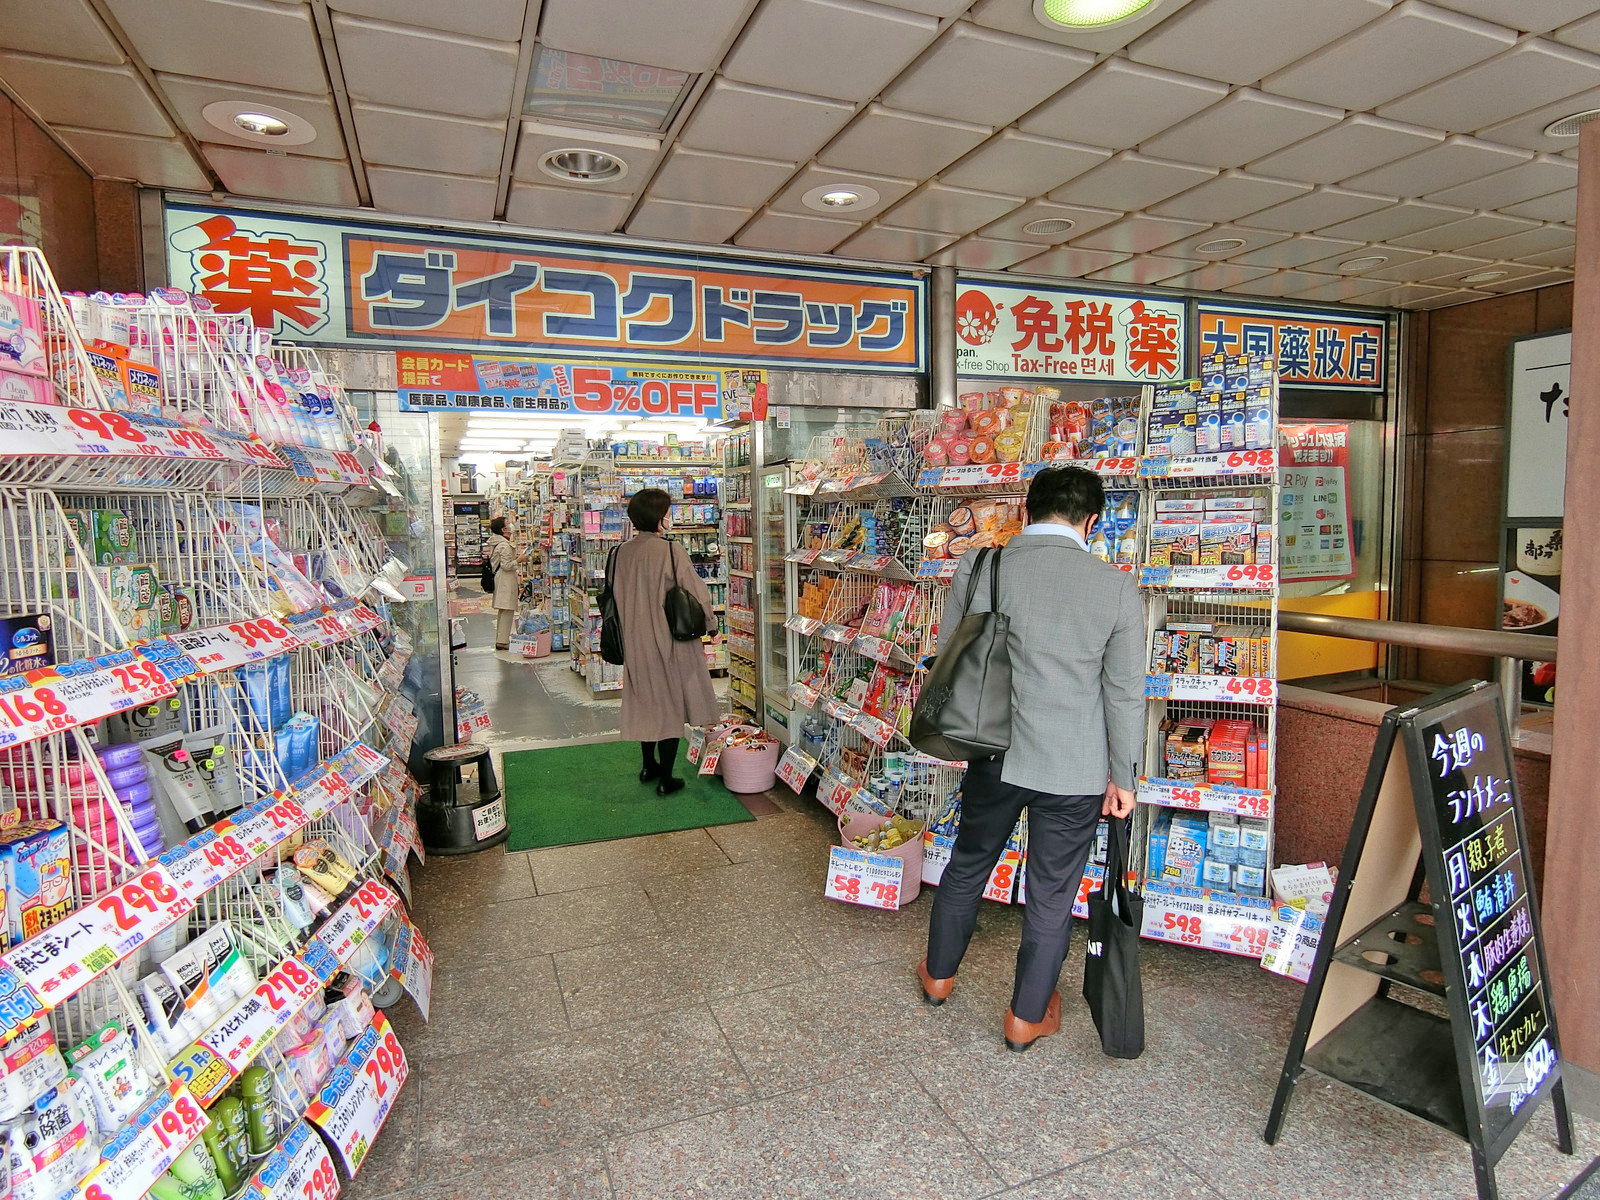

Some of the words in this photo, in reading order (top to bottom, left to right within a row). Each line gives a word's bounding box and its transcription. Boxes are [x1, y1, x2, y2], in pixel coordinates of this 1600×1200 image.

[199, 233, 323, 331] 薬
[361, 248, 909, 351] ダイコクドラッグ
[1010, 295, 1116, 356] 免税
[1129, 313, 1178, 376] 薬
[401, 357, 470, 373] 会員カード
[985, 360, 1010, 374] Shop
[1011, 354, 1077, 374] Tax-Free
[1080, 357, 1115, 376] 면세
[402, 371, 442, 386] 提示で
[552, 365, 572, 397] さらに
[572, 368, 718, 414] 5%OFF
[722, 389, 738, 401] EVE
[408, 393, 569, 410] 医薬品、健康食品、衛生用品が
[1540, 381, 1571, 424] た
[68, 409, 148, 442] 98
[88, 443, 110, 453] 128
[138, 443, 165, 455] 107
[167, 429, 217, 450] 478
[202, 449, 225, 458] 525
[237, 440, 277, 461] 148
[1172, 456, 1218, 464] ウナ虫よけ当番
[1226, 449, 1274, 468] 698
[331, 451, 364, 474] 198
[945, 467, 983, 475] スープはるさめ
[986, 463, 1020, 478] 98
[1095, 457, 1136, 470] 198
[1227, 564, 1273, 581] 698
[350, 606, 378, 624] 198
[229, 618, 288, 648] 398
[316, 616, 344, 635] 298
[177, 632, 231, 651] 温泡クール
[281, 637, 300, 648] 437
[877, 640, 893, 656] 58
[55, 657, 97, 678] 今だけ
[198, 653, 225, 665] 各種
[112, 660, 166, 693] 258
[1174, 677, 1218, 686] ブラックキャップ
[151, 683, 174, 698] 283
[1226, 678, 1273, 696] 498
[0, 688, 67, 727] 168
[119, 698, 134, 708] 348
[46, 713, 78, 732] 184
[475, 715, 490, 728] 138
[354, 744, 379, 766] 198
[703, 756, 716, 769] 138
[1211, 750, 1242, 762] ホウ酸ダンゴ
[1431, 727, 1484, 778] 今週の
[179, 774, 193, 782] GEL
[782, 762, 794, 776] 128
[319, 771, 347, 796] 348
[831, 783, 852, 809] 158
[1171, 788, 1201, 803] 548
[1237, 796, 1270, 811] 298
[265, 799, 303, 828] 298
[293, 813, 310, 827] 327
[477, 811, 503, 827] お使い下さい
[481, 803, 500, 817] ご自由に
[1252, 809, 1269, 817] 327
[203, 835, 245, 867] 498
[233, 852, 253, 867] 547
[1449, 851, 1467, 895] 月
[1467, 823, 1508, 873] 親子煮
[830, 860, 864, 872] キレートレモン
[834, 874, 861, 895] 58
[870, 881, 899, 901] 78
[989, 887, 1008, 900] 192
[1146, 881, 1170, 894] 今だけ
[1174, 886, 1203, 899] 値下げ!
[1292, 887, 1320, 897] 立体マスク
[98, 871, 178, 931] 298
[349, 881, 388, 919] 298
[384, 894, 398, 909] 327
[844, 893, 860, 902] 62
[1210, 892, 1236, 904] 今だけ
[1240, 896, 1272, 910] 値下げ!
[166, 897, 193, 919] 327
[1207, 906, 1272, 923] 虫よけサマーリキッド
[1164, 912, 1202, 935] 598
[1457, 902, 1476, 940] 火
[125, 931, 145, 949] 720
[1180, 934, 1202, 944] 657
[1230, 924, 1269, 946] 298
[13, 921, 94, 976] 熱さまシート
[40, 962, 82, 993] 各種
[1468, 951, 1484, 988] 水
[255, 960, 309, 1010] 278
[298, 978, 319, 1000] 305
[211, 998, 262, 1048] メンズビオレ洗顔
[1472, 1000, 1494, 1041] 木
[89, 1052, 110, 1069] キレイ
[111, 1037, 131, 1054] キレイ
[1482, 1045, 1499, 1094] 金
[1499, 1010, 1541, 1064] 牛すじカレー
[320, 1064, 355, 1108] 今だけ
[347, 1024, 381, 1069] 値下げ!
[366, 1032, 403, 1099] 298
[395, 1061, 408, 1088] 327
[40, 1111, 72, 1140] 除菌
[153, 1096, 199, 1150] 198
[185, 1115, 207, 1140] 217
[100, 1122, 141, 1161] 今だけ
[193, 1143, 215, 1179] GATSBY
[303, 1155, 334, 1200] 298
